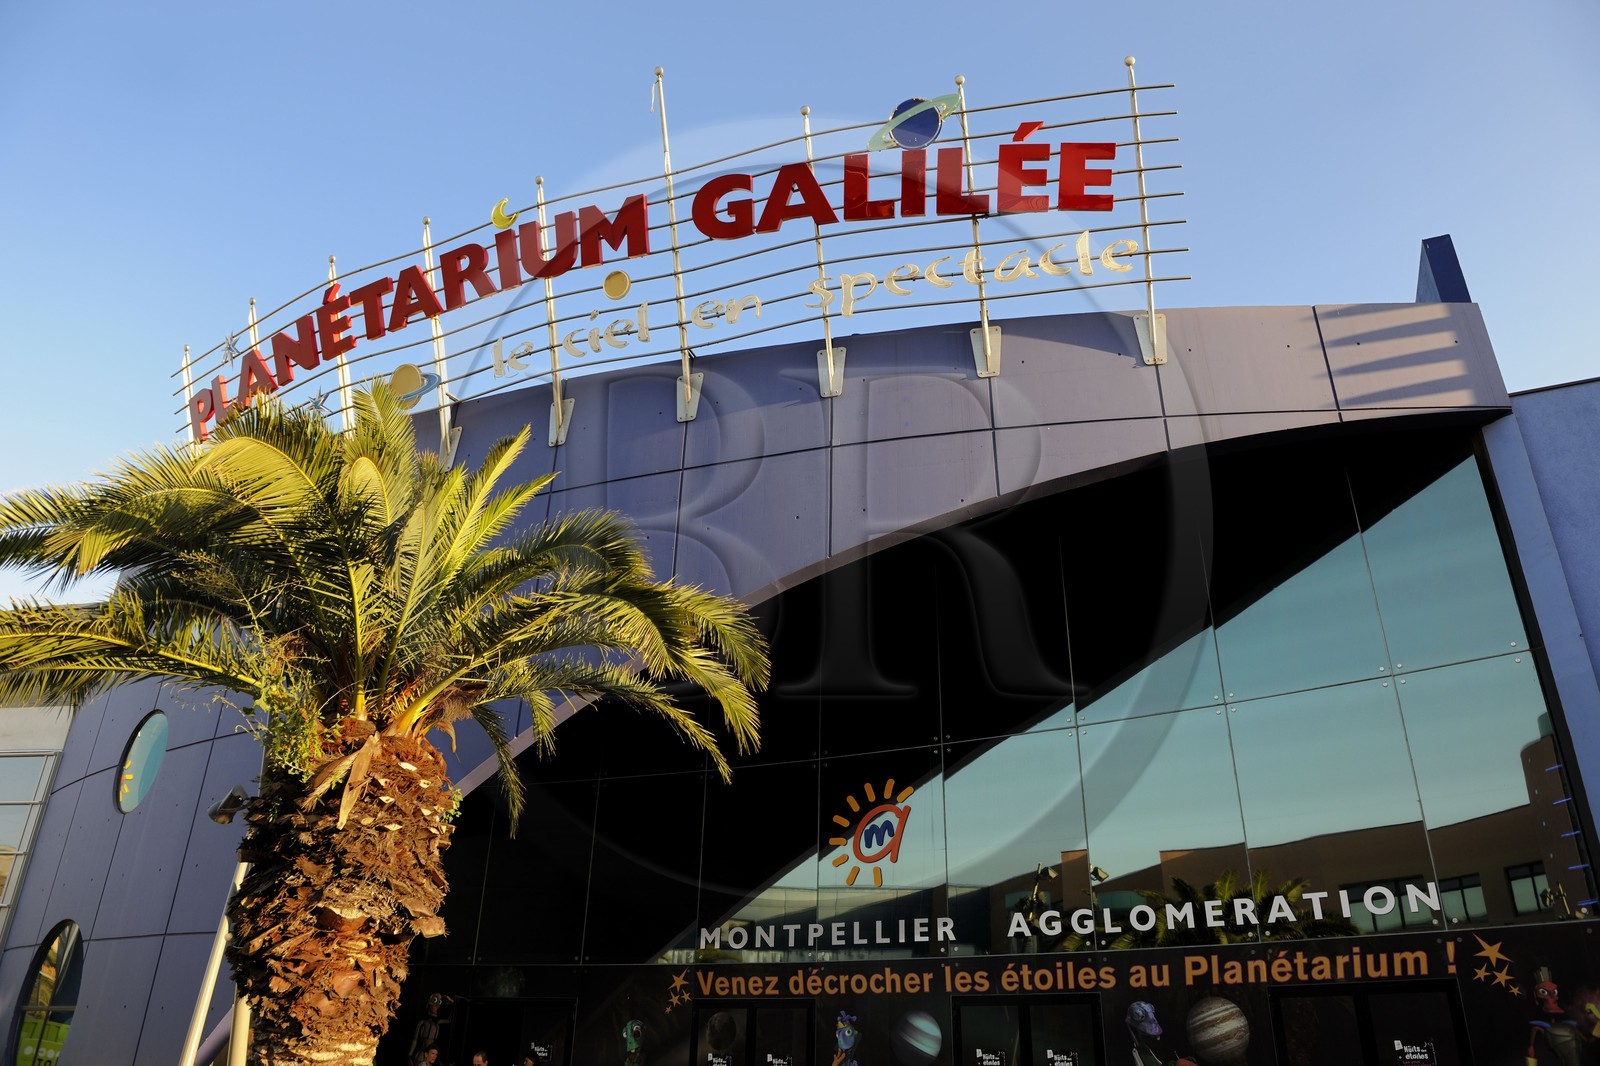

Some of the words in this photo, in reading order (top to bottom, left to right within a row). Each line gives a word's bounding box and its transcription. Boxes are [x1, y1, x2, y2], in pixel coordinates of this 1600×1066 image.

[188, 192, 651, 440] PLANÉTARIUM
[691, 120, 1119, 240] GALILÉE
[491, 336, 535, 379] le
[561, 301, 651, 358] ciel
[690, 294, 764, 330] en
[804, 229, 1140, 318] spectacle
[699, 916, 957, 950] MONTPELLIER
[1006, 881, 1442, 938] AGGLOMERATION
[695, 970, 780, 997] Venez
[788, 966, 934, 996] décrocher
[944, 964, 991, 993] les
[1000, 961, 1118, 993] étoiles
[1128, 963, 1172, 988] au
[1184, 945, 1430, 986] Planétarium
